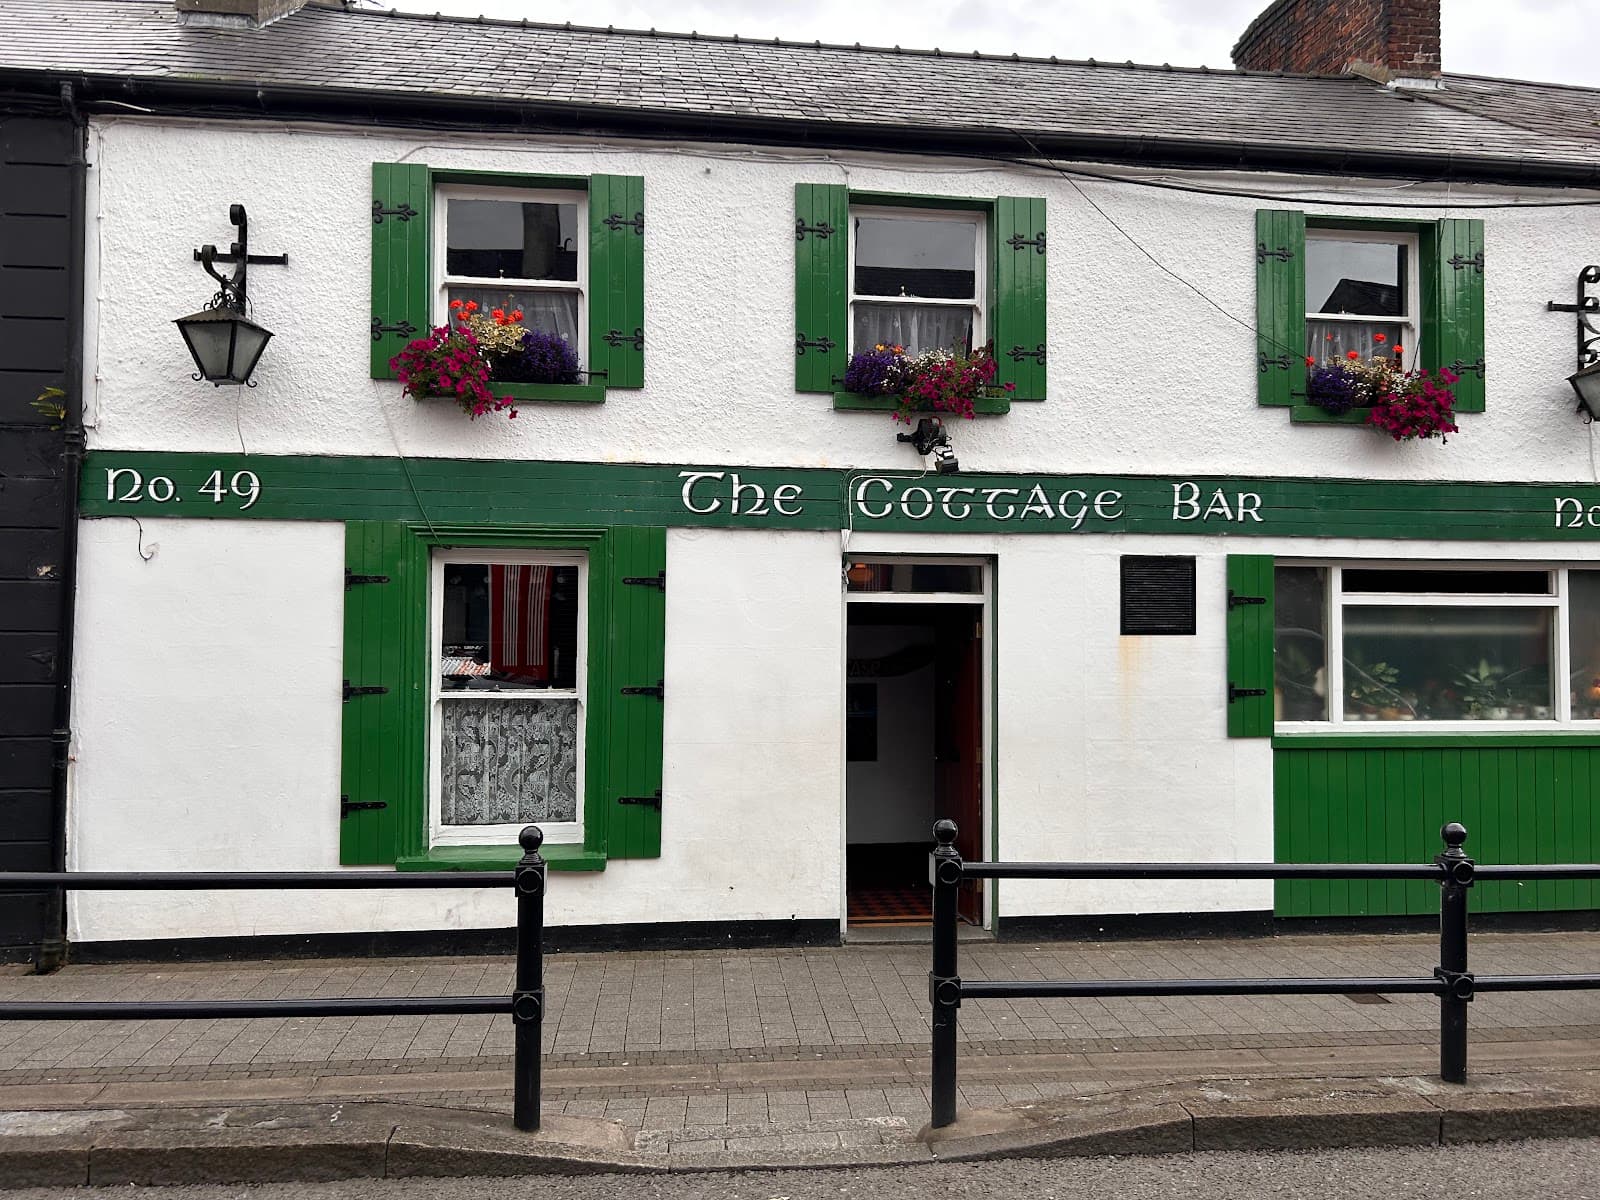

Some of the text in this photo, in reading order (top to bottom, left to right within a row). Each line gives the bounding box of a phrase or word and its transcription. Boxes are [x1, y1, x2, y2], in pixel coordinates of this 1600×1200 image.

[105, 467, 260, 510] No. 49
[678, 471, 803, 516] The
